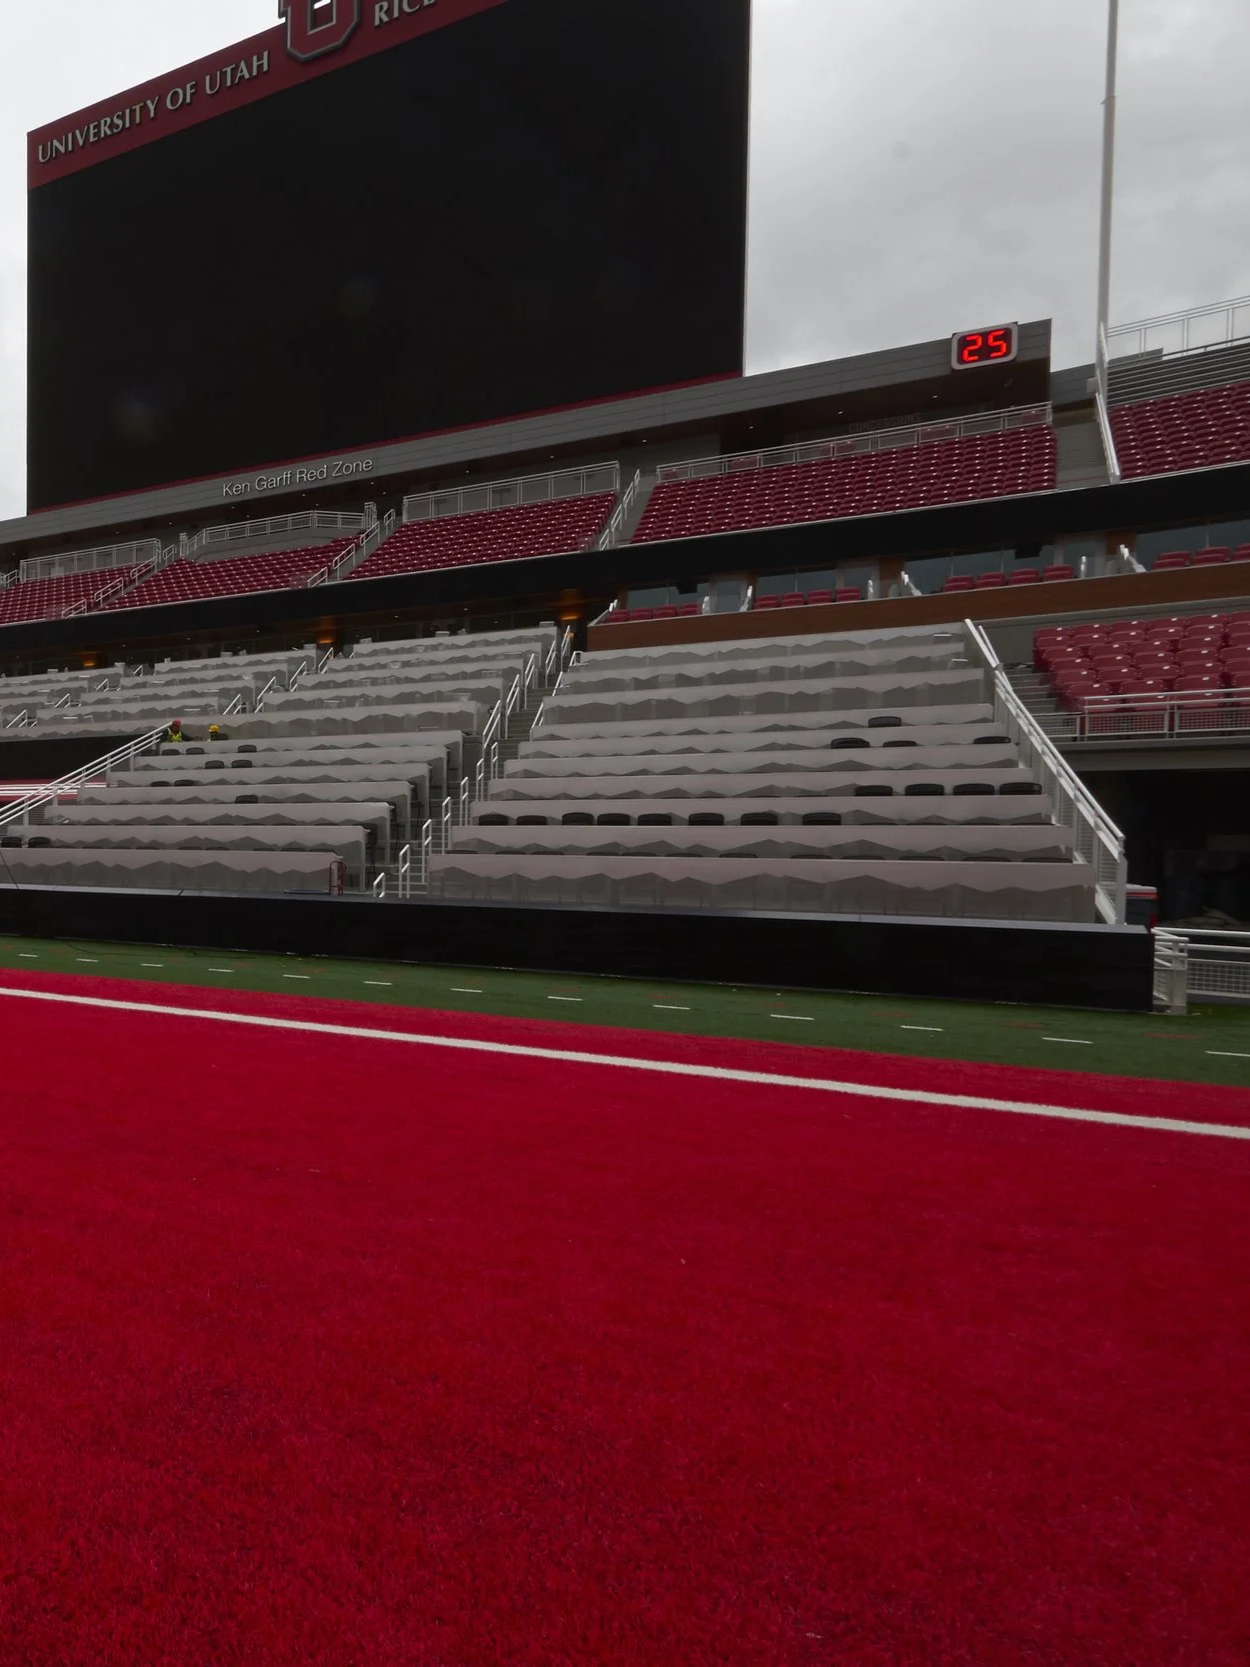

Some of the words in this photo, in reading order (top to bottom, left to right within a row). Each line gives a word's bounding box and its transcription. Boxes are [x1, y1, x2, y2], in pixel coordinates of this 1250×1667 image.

[374, 0, 436, 27] RIC
[38, 96, 159, 163] UNIVERSITY
[165, 81, 196, 111] OF
[205, 50, 269, 95] UTAH
[962, 329, 1007, 363] 25
[222, 482, 251, 496] Ken
[255, 471, 292, 491] Garff
[296, 465, 327, 483] Red
[332, 459, 373, 477] Zone
